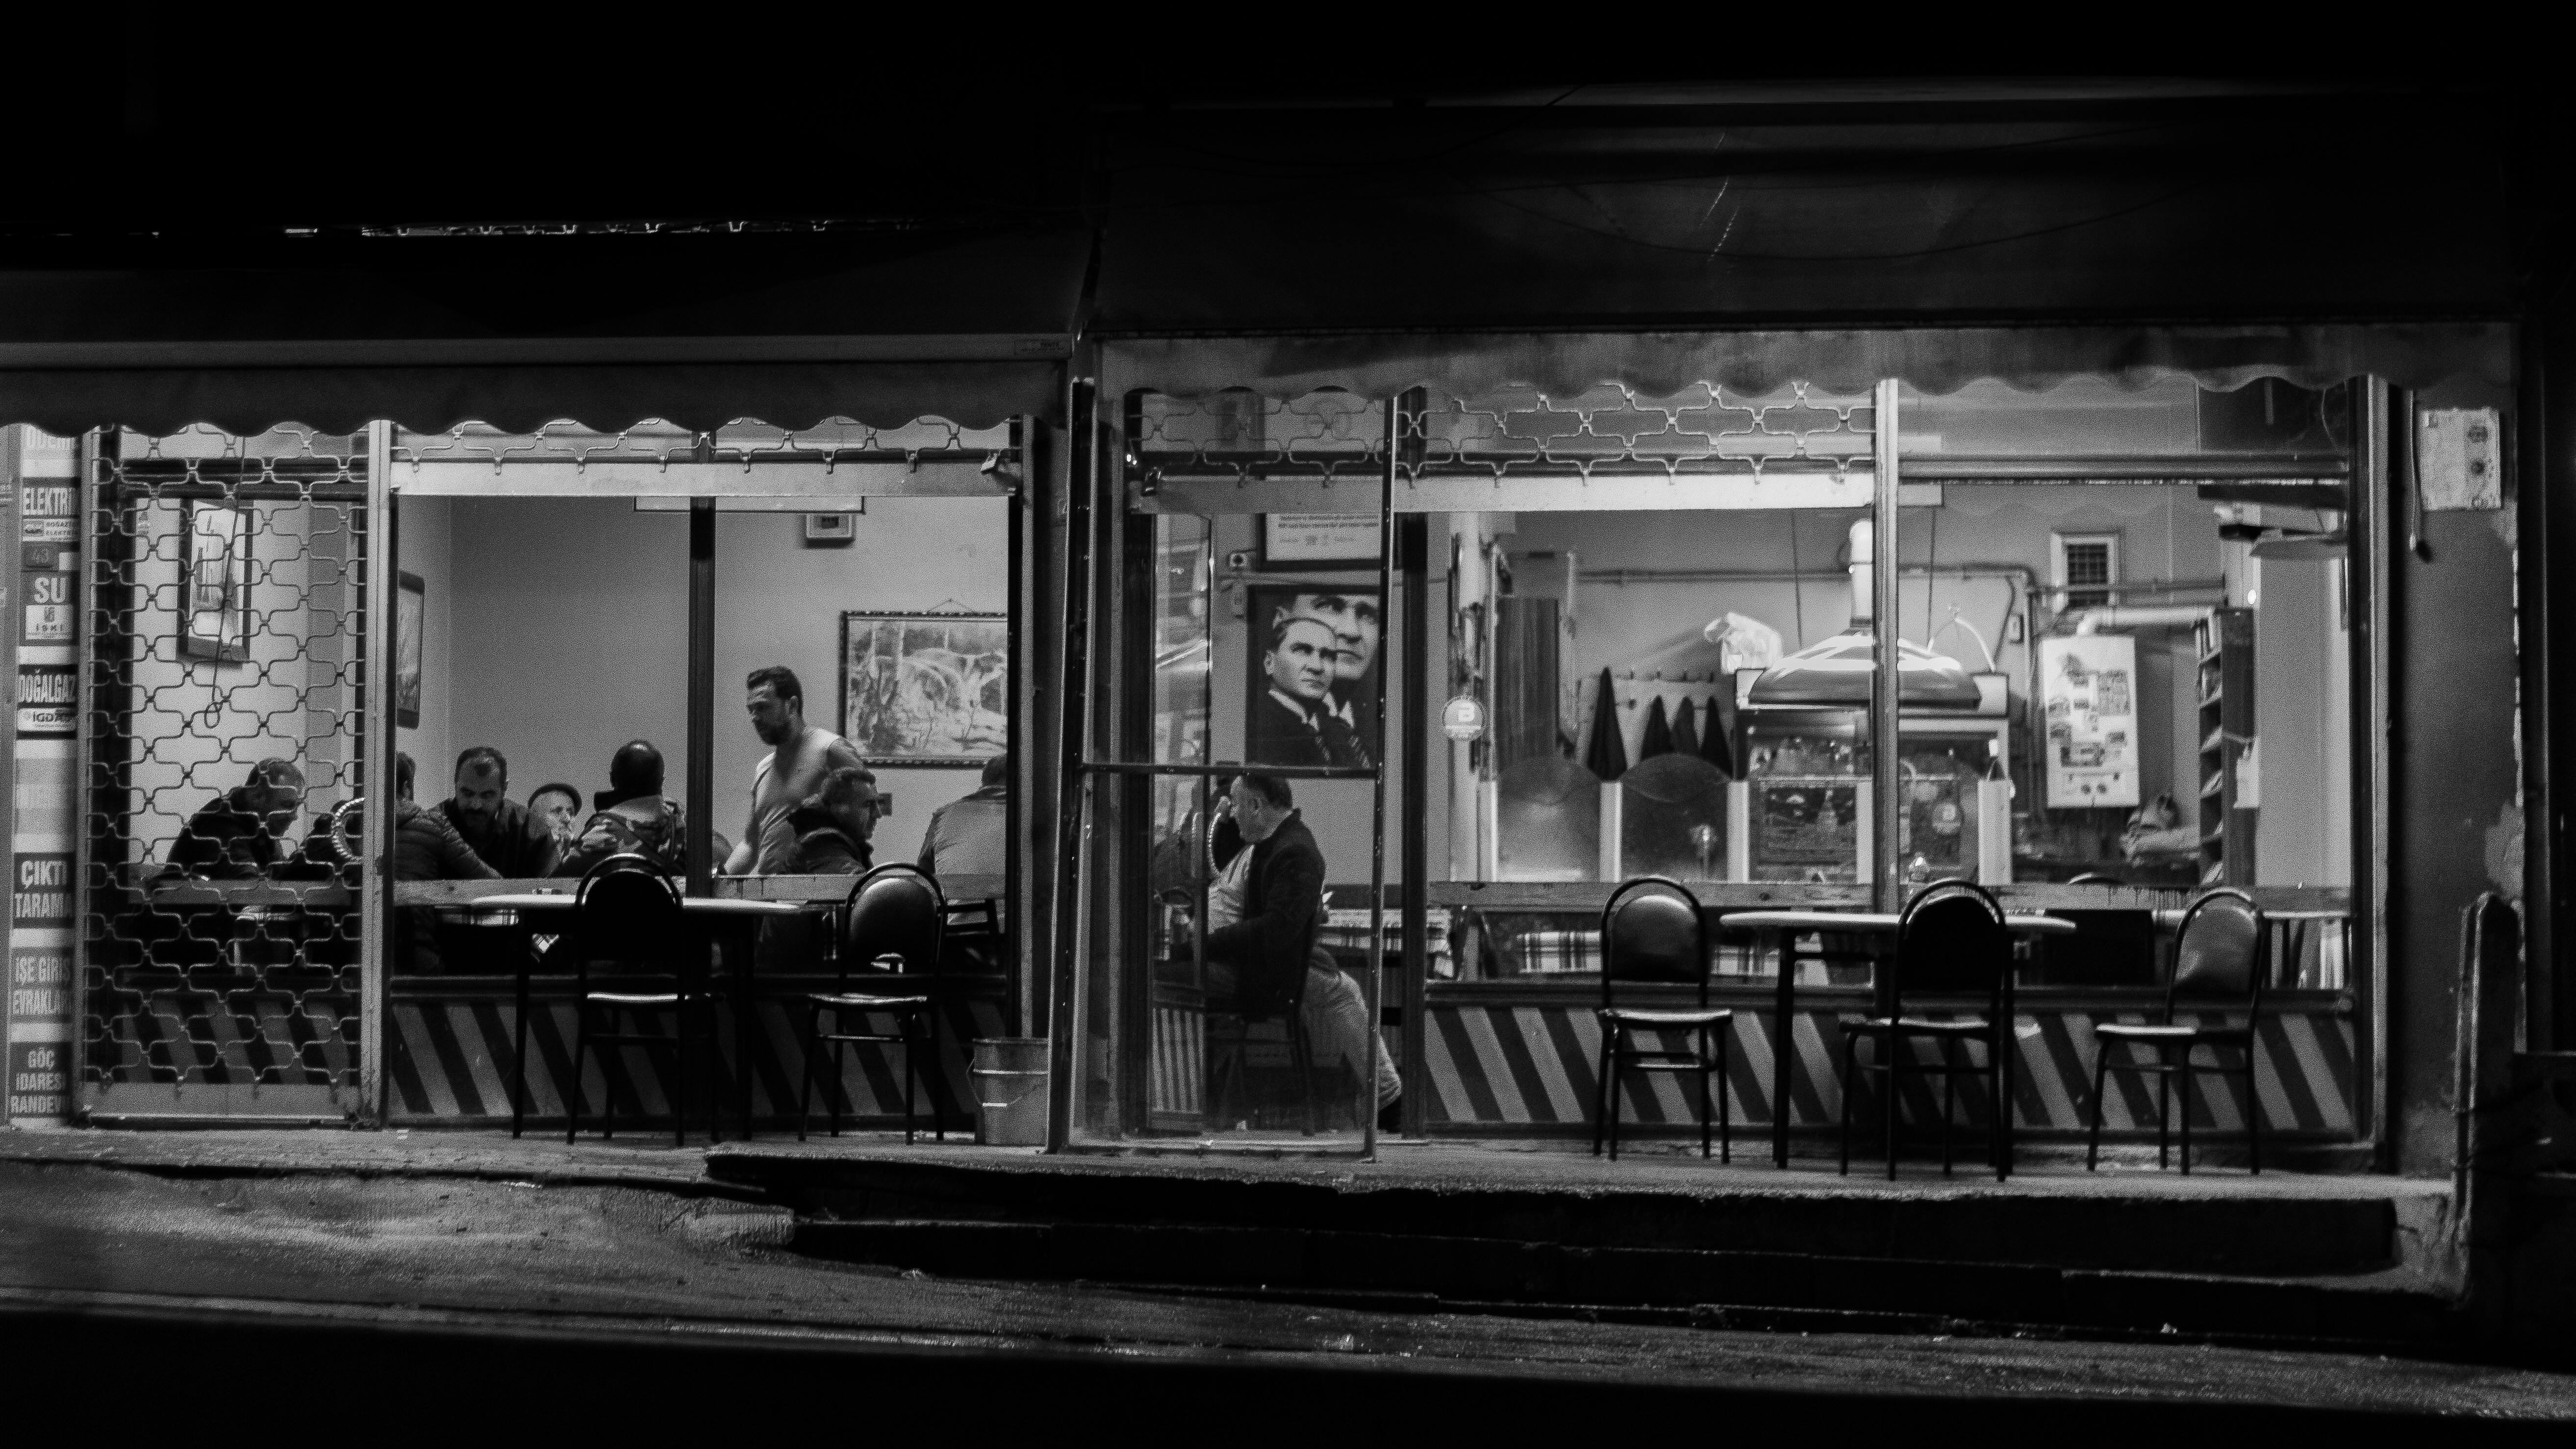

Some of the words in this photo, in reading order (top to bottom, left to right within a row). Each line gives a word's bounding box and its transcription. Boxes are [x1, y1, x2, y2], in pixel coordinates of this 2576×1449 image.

[34, 576, 68, 603] SU
[18, 669, 77, 703] DOĞALGAZ
[21, 860, 68, 889] ÇIKTI
[15, 956, 36, 986] İŞE
[27, 1047, 55, 1070] GÖÇ
